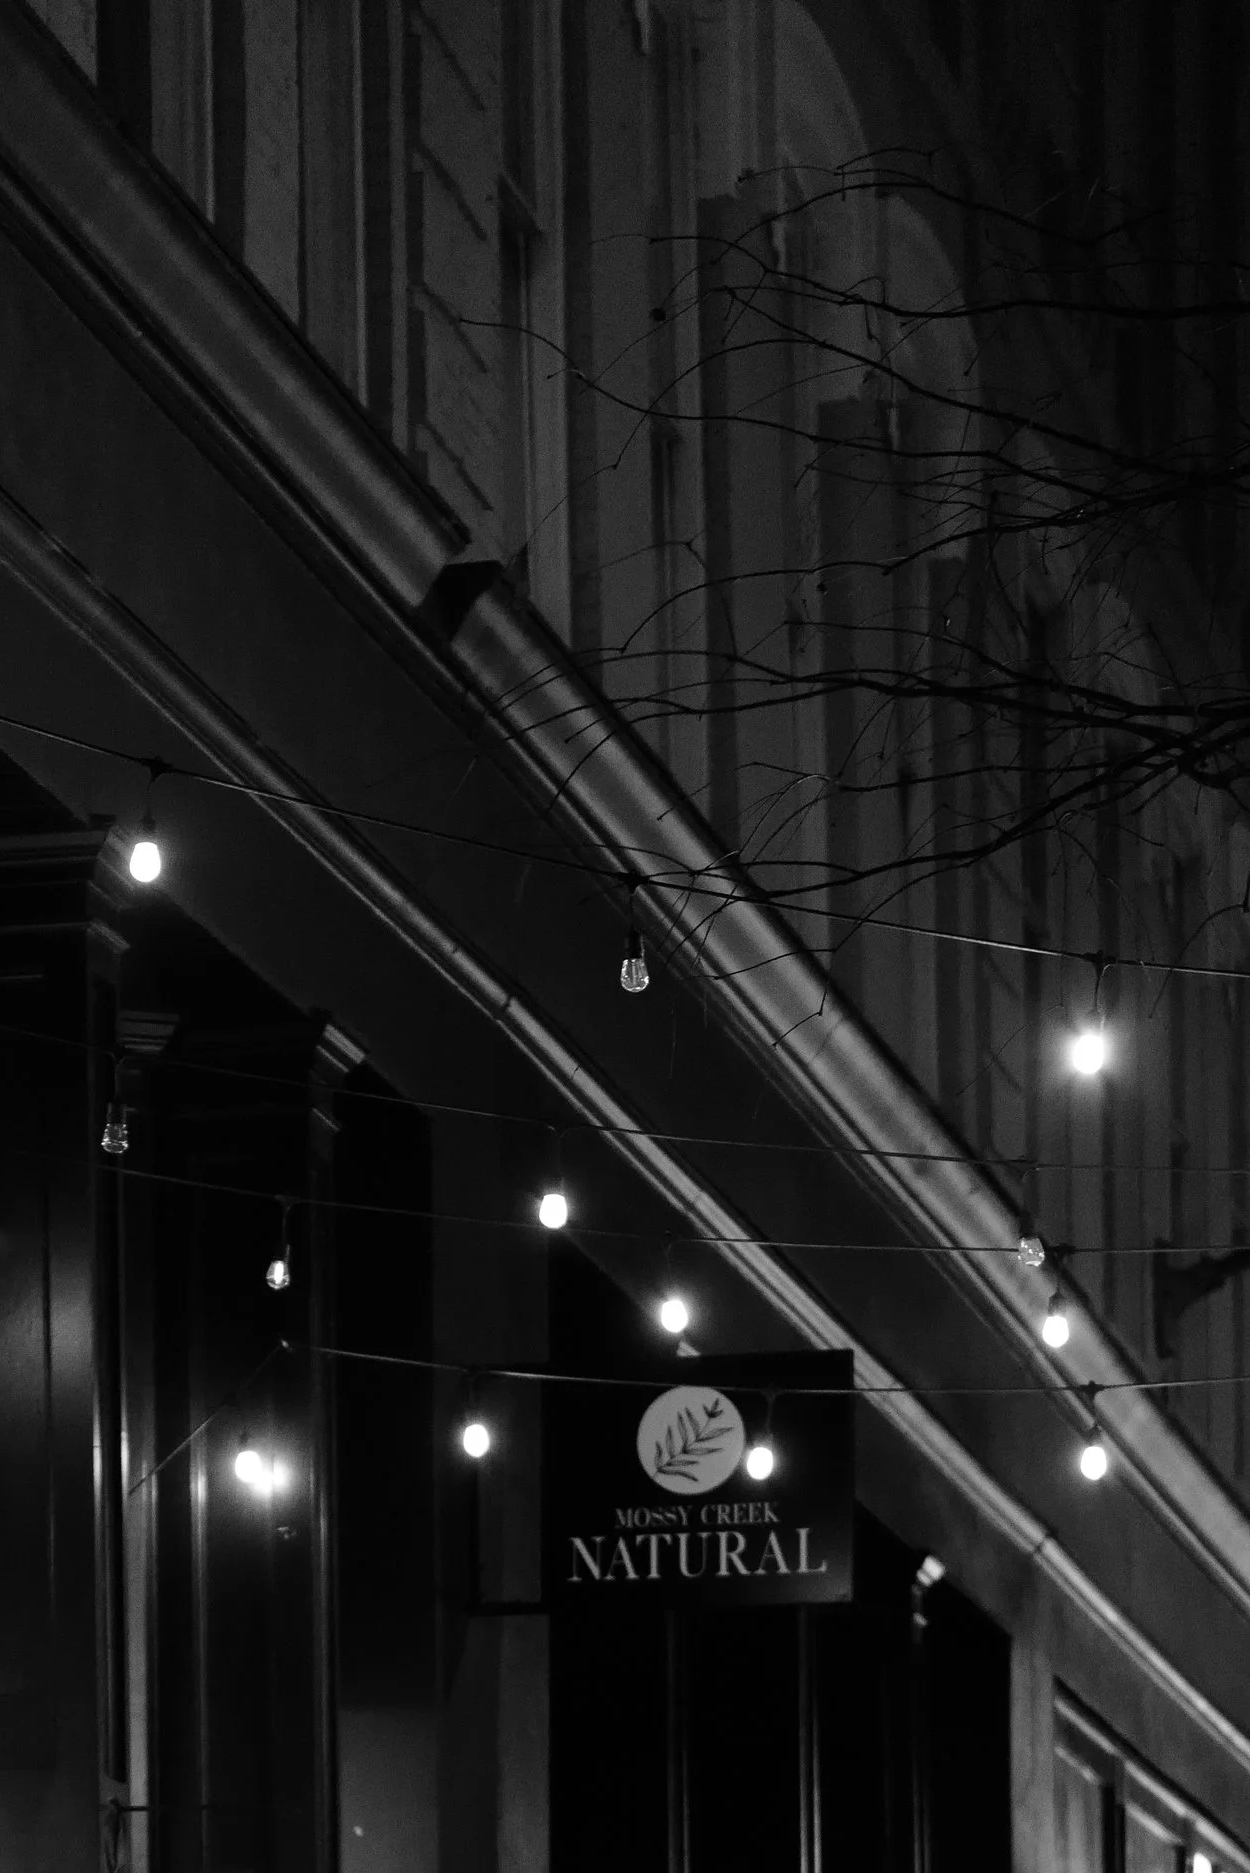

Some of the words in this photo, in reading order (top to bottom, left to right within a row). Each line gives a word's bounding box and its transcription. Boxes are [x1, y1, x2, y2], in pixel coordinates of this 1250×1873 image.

[613, 1503, 692, 1530] MOSSY
[699, 1501, 781, 1526] CREEK
[566, 1527, 828, 1583] NATURAL
